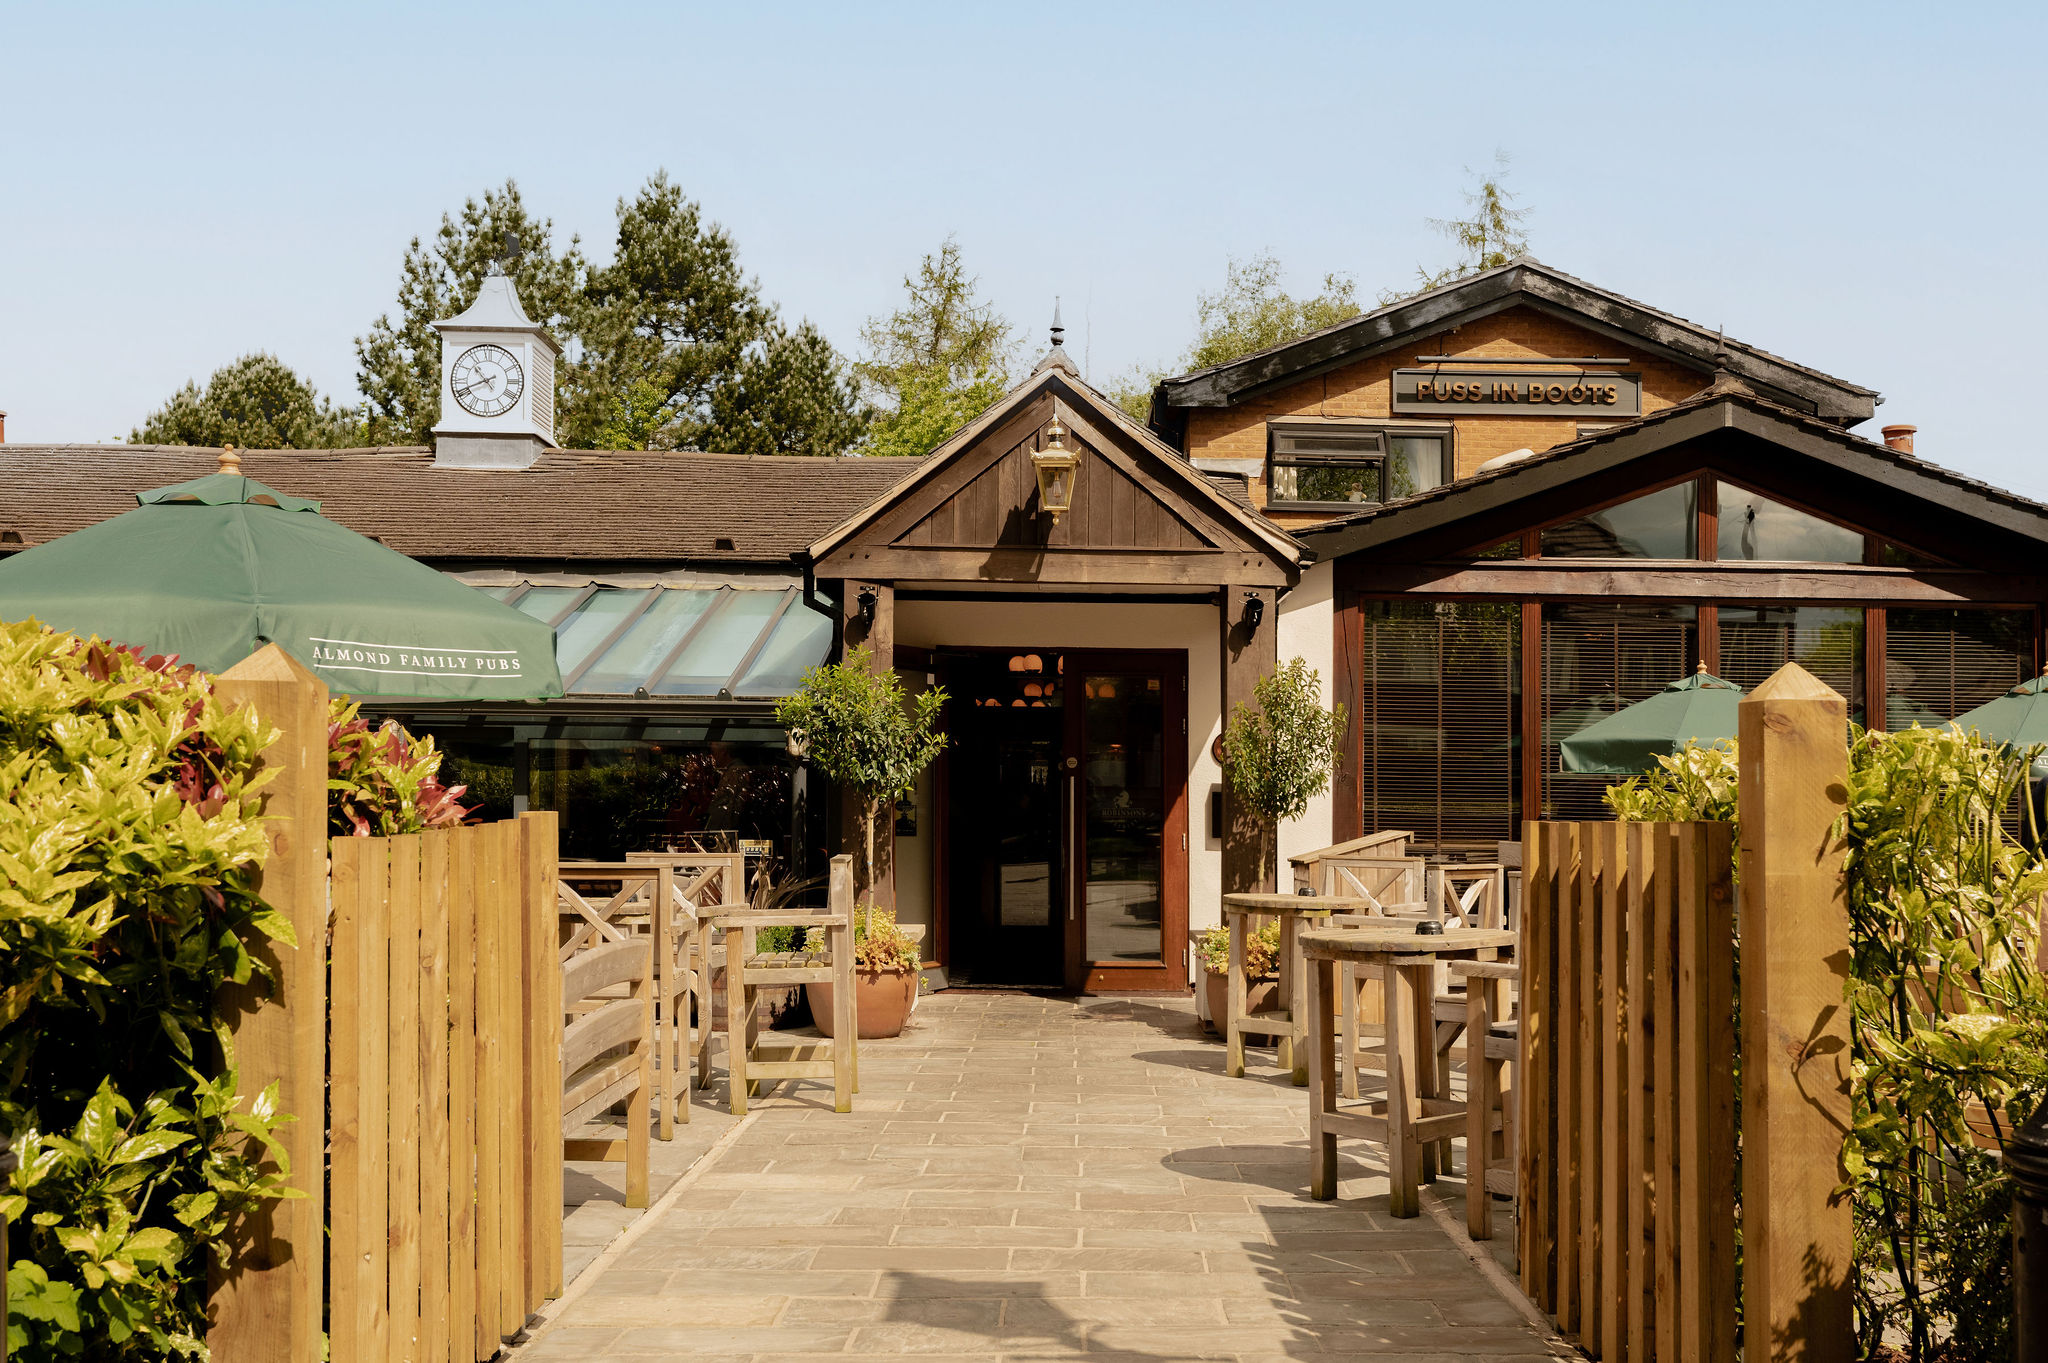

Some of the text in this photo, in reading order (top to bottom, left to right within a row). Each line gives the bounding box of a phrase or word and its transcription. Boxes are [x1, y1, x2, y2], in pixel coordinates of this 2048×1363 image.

[1416, 381, 1618, 405] PUSS IN BOOTS
[313, 646, 521, 671] ALMOND FAMILY PUBS
